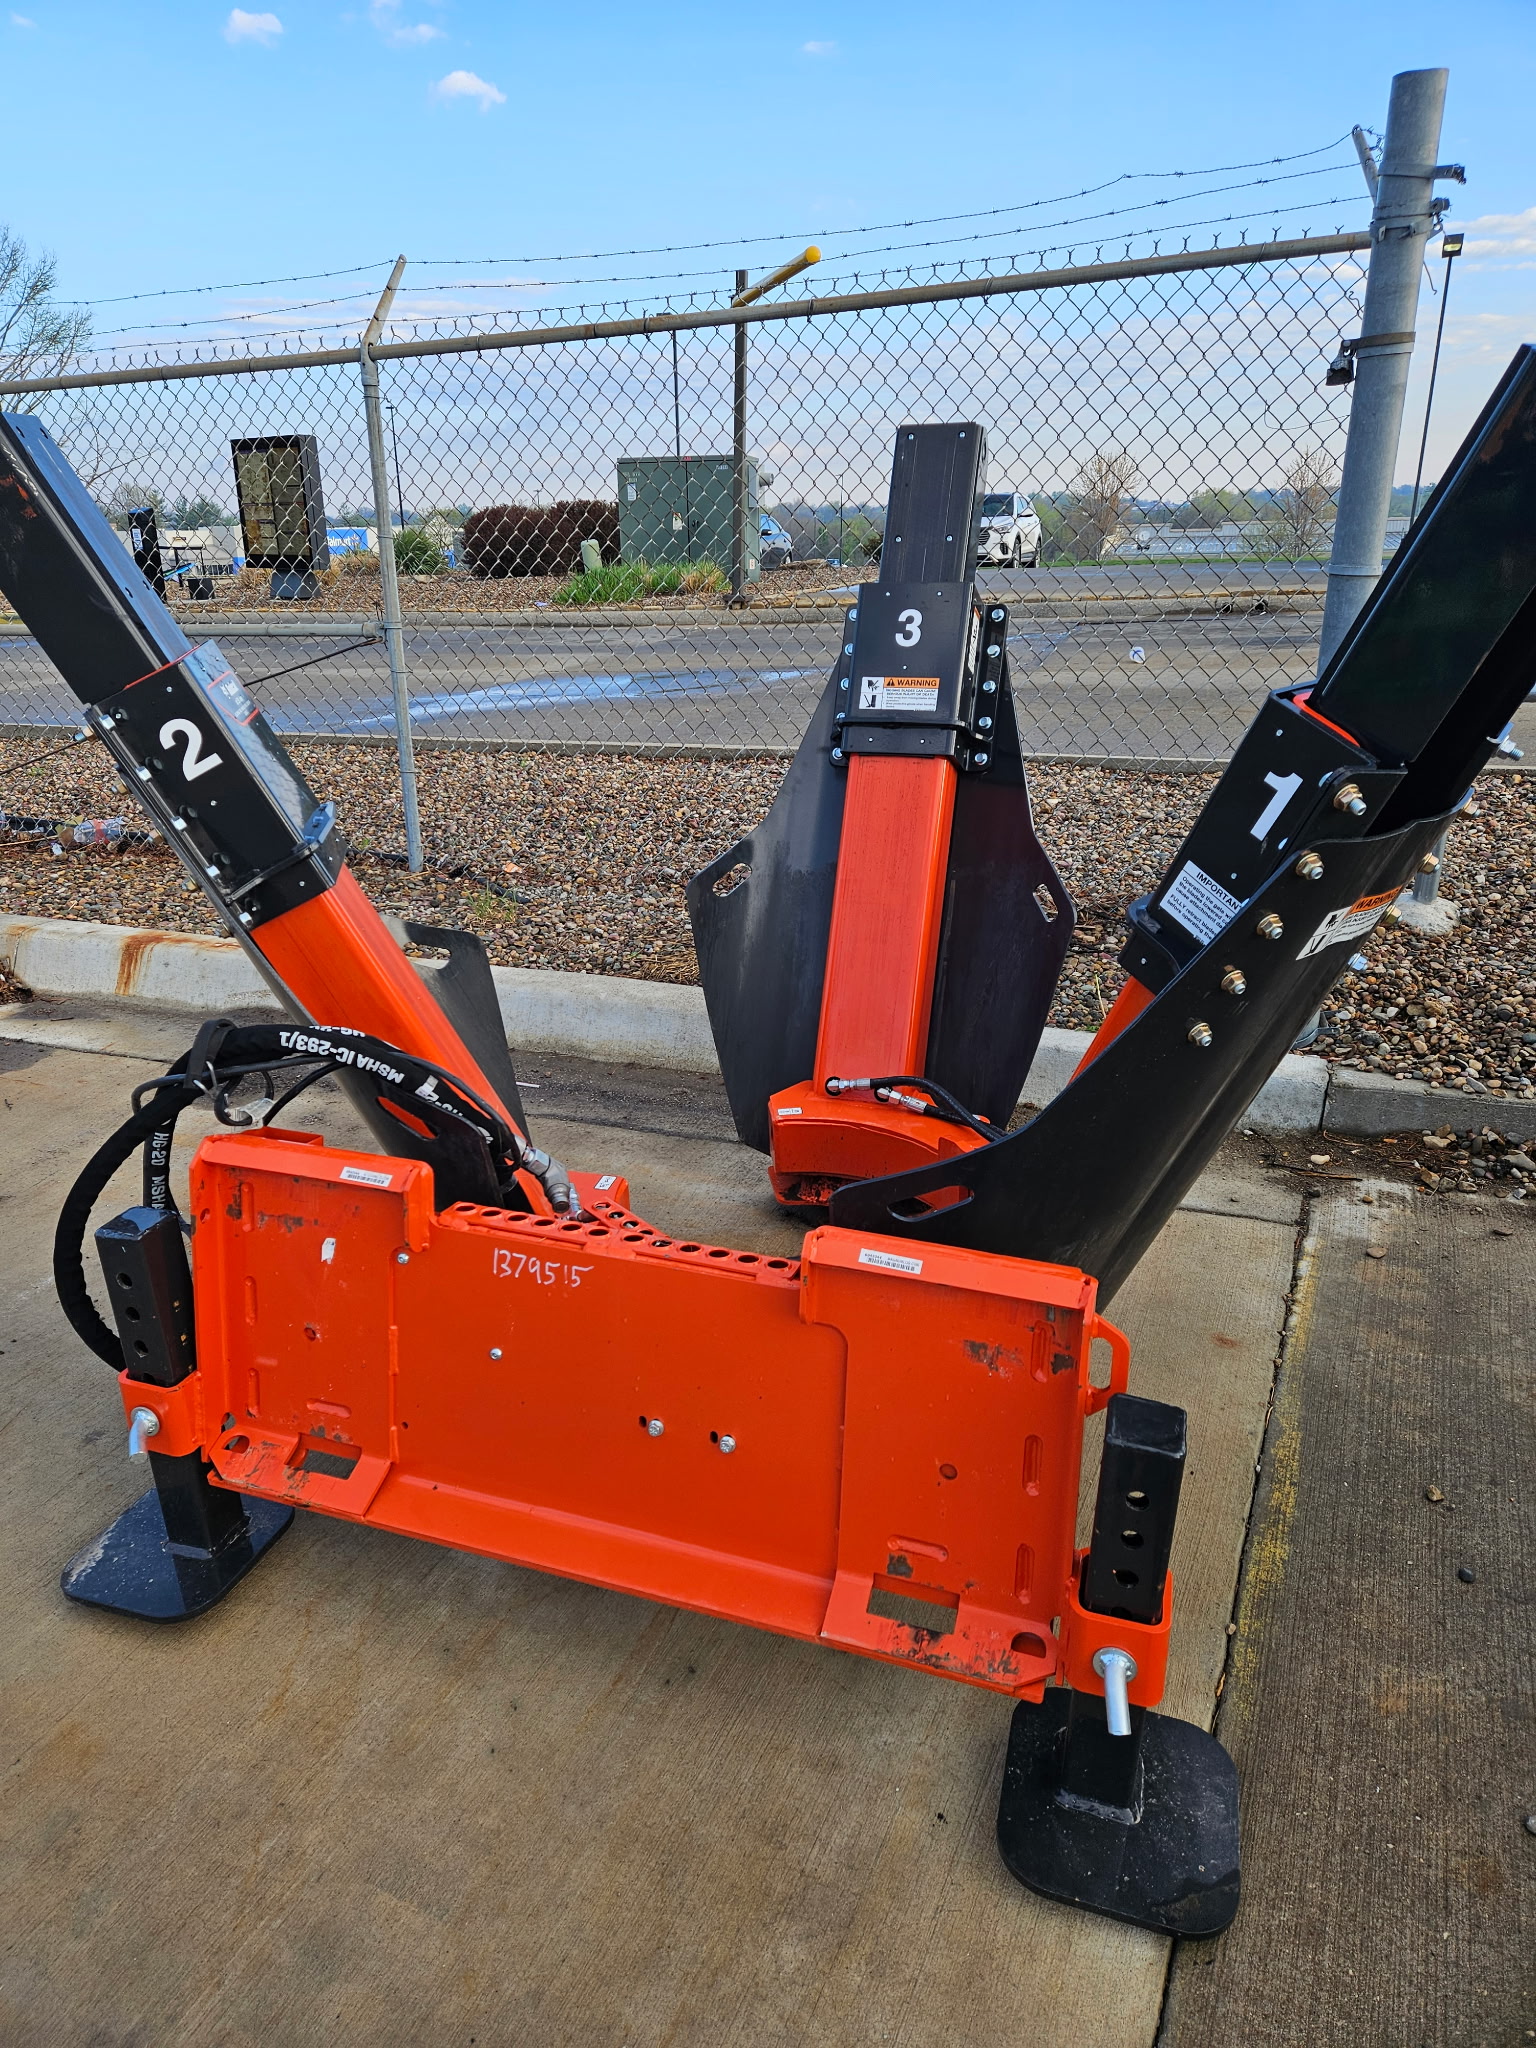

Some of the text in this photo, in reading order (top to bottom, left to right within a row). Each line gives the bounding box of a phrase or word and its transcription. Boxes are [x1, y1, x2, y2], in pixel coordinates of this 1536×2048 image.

[895, 608, 923, 647] 3
[159, 718, 224, 781] 2
[1250, 771, 1303, 841] 1
[1170, 893, 1186, 909] FULLY
[1185, 907, 1202, 923] retract
[1175, 887, 1190, 900] cause
[1189, 899, 1217, 923] attachment
[1179, 881, 1187, 890] the
[1187, 888, 1203, 904] blades
[1202, 901, 1222, 920] lowered
[1182, 876, 1206, 899] Operating
[1205, 895, 1214, 905] the
[1212, 903, 1225, 915] gate
[1196, 871, 1240, 911] IMPORTAN
[1167, 899, 1182, 914] before
[1181, 913, 1204, 934] operating
[1203, 931, 1213, 940] the
[279, 1031, 405, 1085] MSHA IC-293/1
[493, 1248, 595, 1287] 1379515
